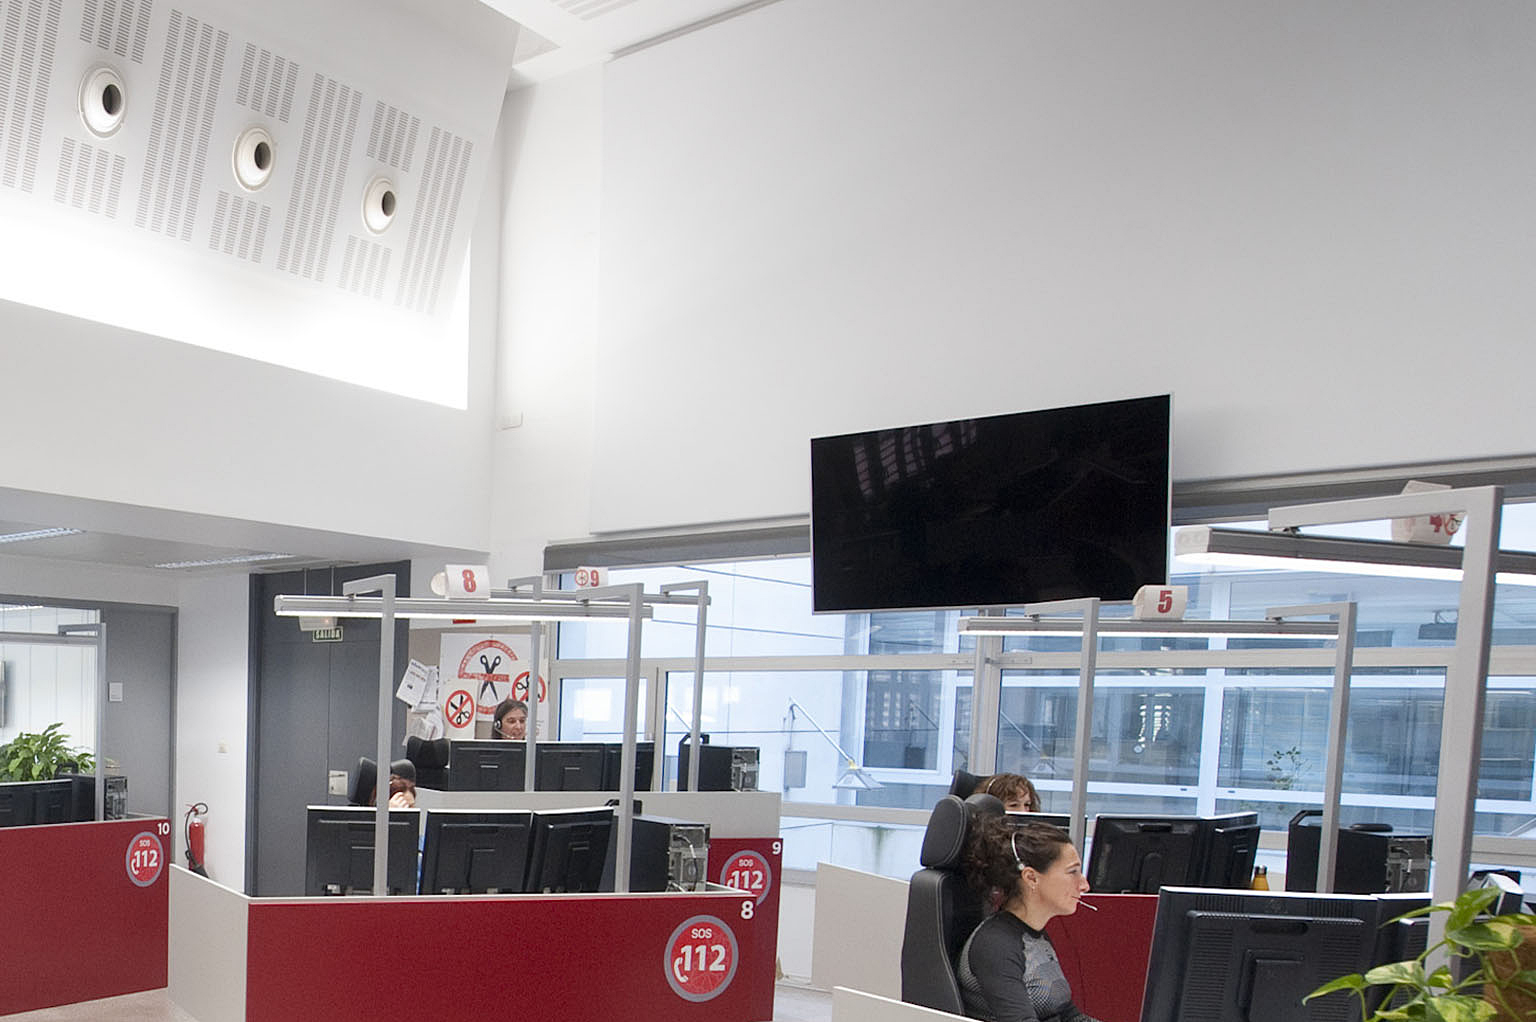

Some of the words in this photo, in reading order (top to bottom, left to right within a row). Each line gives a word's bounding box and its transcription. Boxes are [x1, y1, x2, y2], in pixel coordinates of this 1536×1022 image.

[462, 569, 476, 593] 8
[590, 569, 600, 588] 9
[1157, 590, 1173, 613] 5
[157, 822, 170, 835] 10
[139, 840, 151, 848] SOS
[772, 841, 782, 855] 9
[134, 849, 158, 868] 112
[738, 859, 754, 868] SOS
[730, 870, 763, 889] 112
[740, 901, 754, 919] 8
[691, 928, 713, 939] SOS
[680, 944, 727, 972] 112
